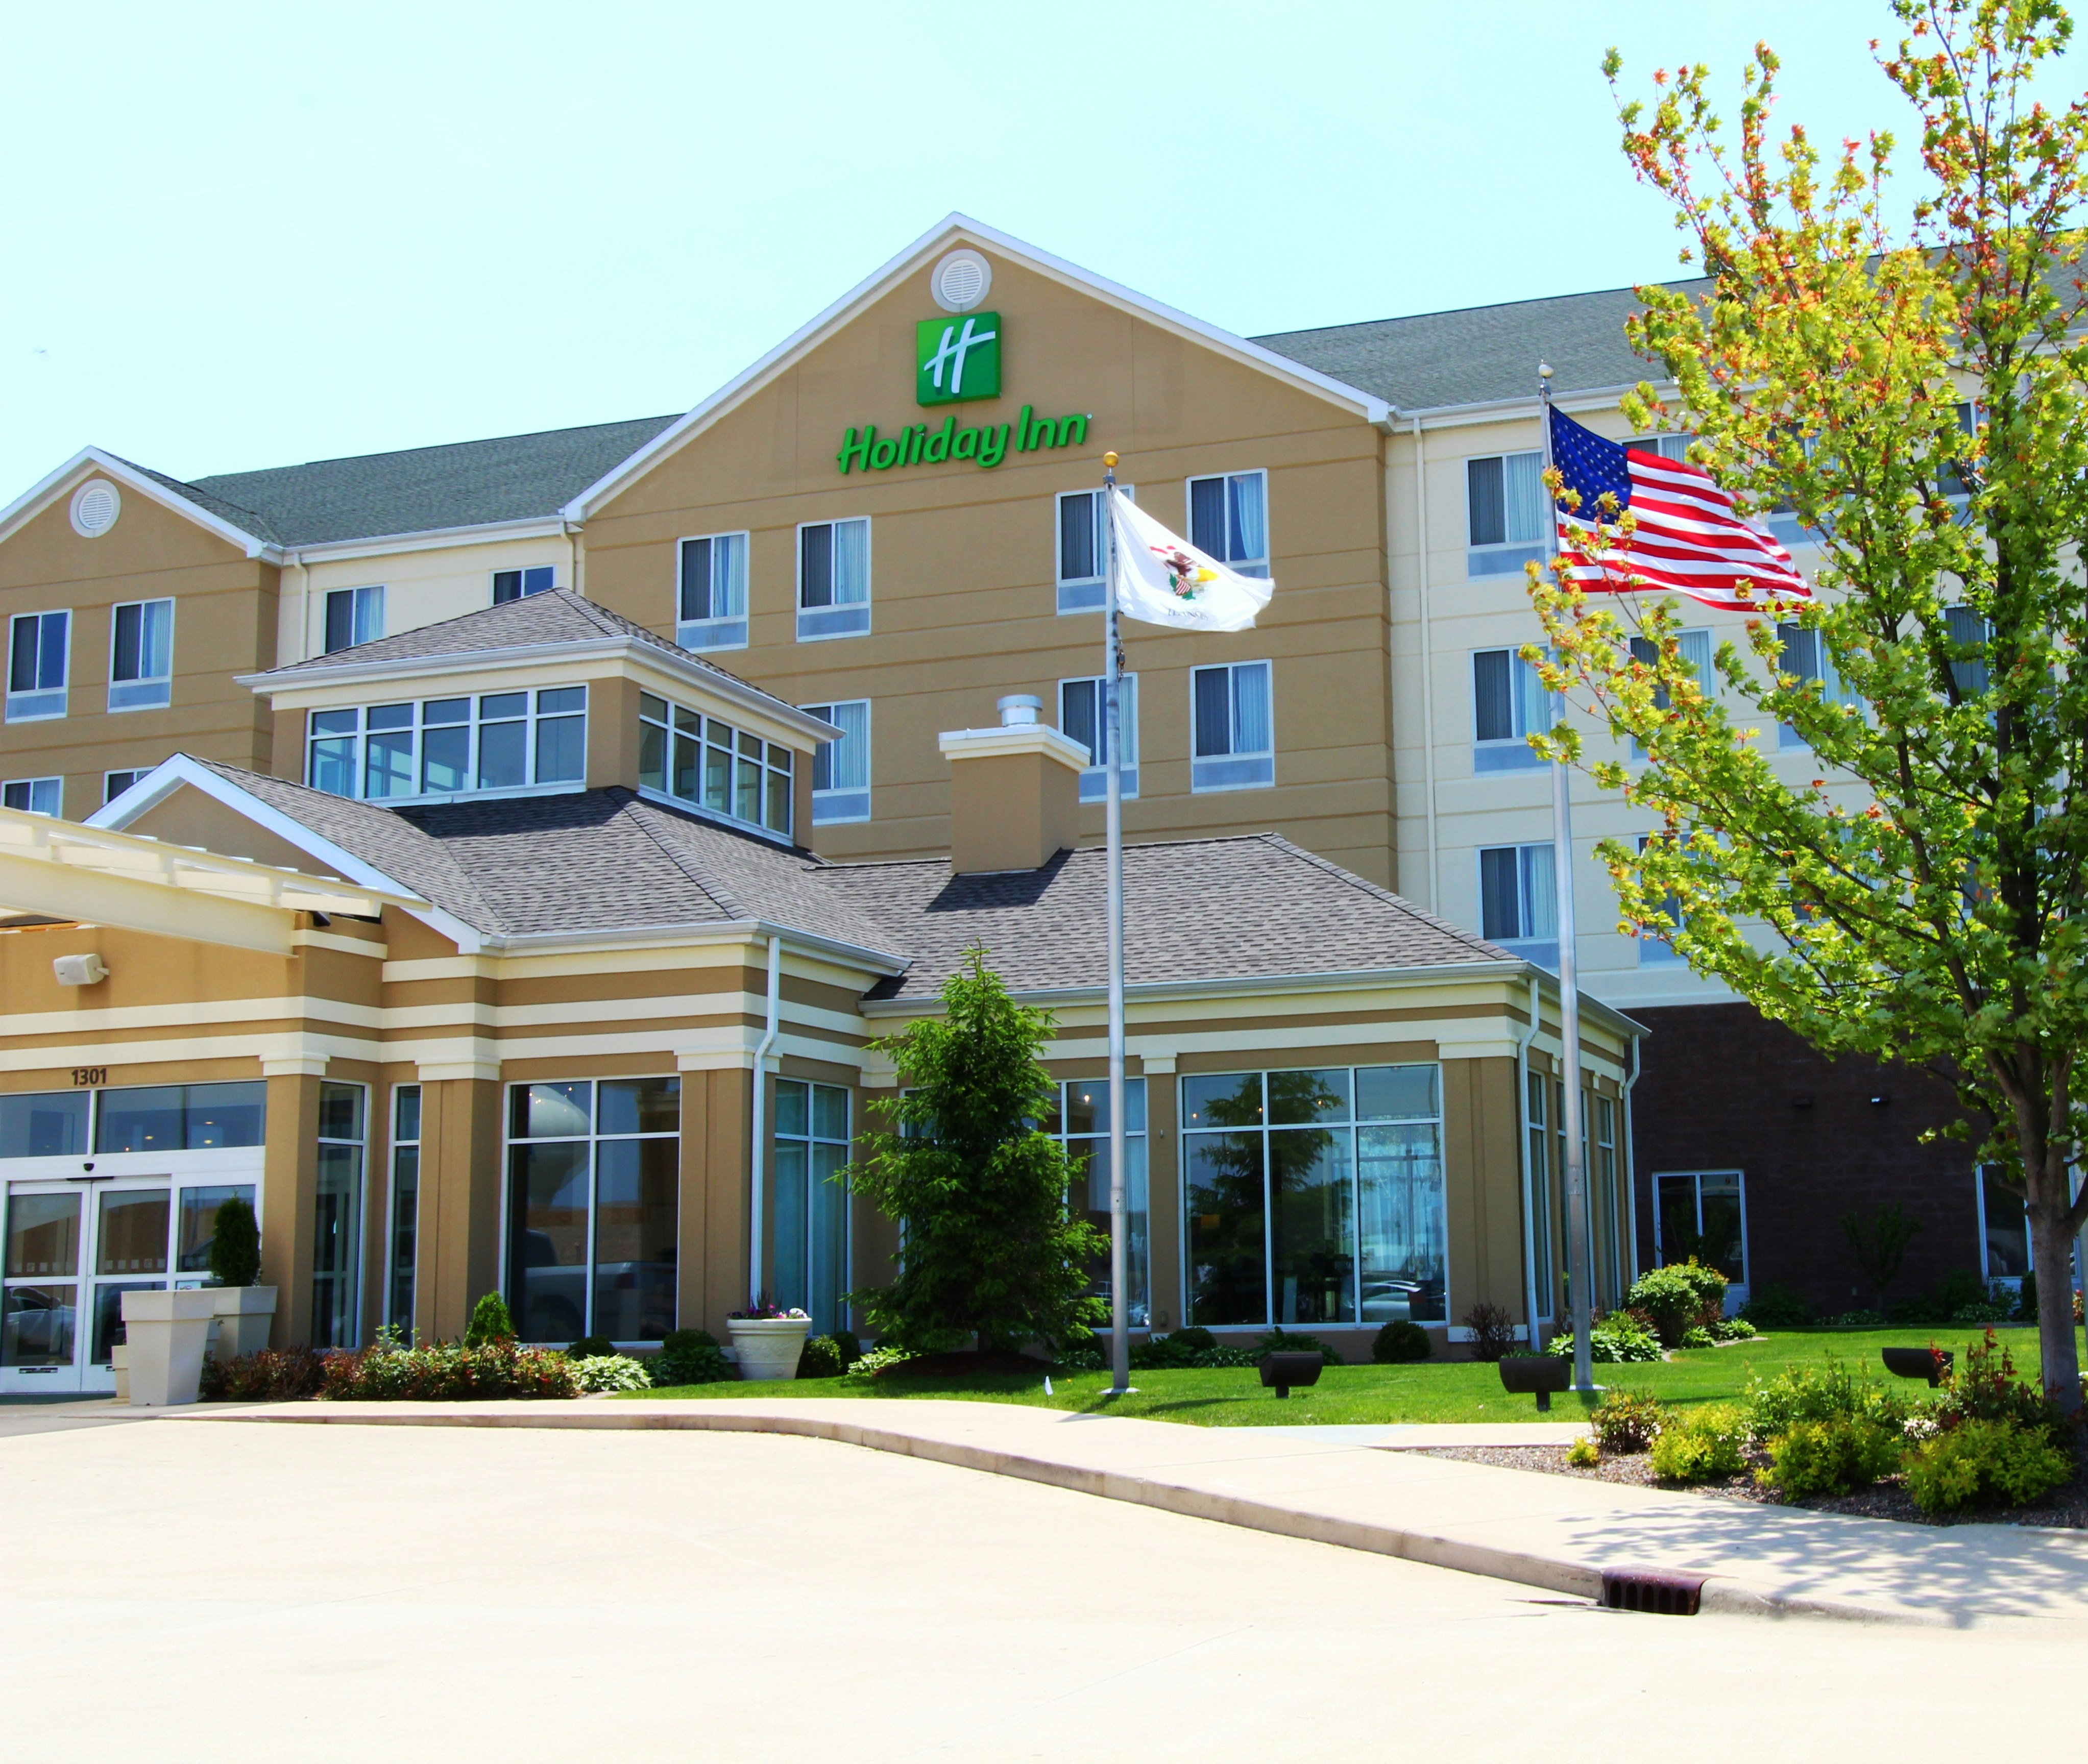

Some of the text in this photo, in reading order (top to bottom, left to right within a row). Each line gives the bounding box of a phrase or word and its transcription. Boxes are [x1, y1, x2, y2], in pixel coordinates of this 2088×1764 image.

[923, 318, 996, 394] H
[836, 405, 1089, 474] Holiday Inn
[71, 1068, 107, 1086] 1301
